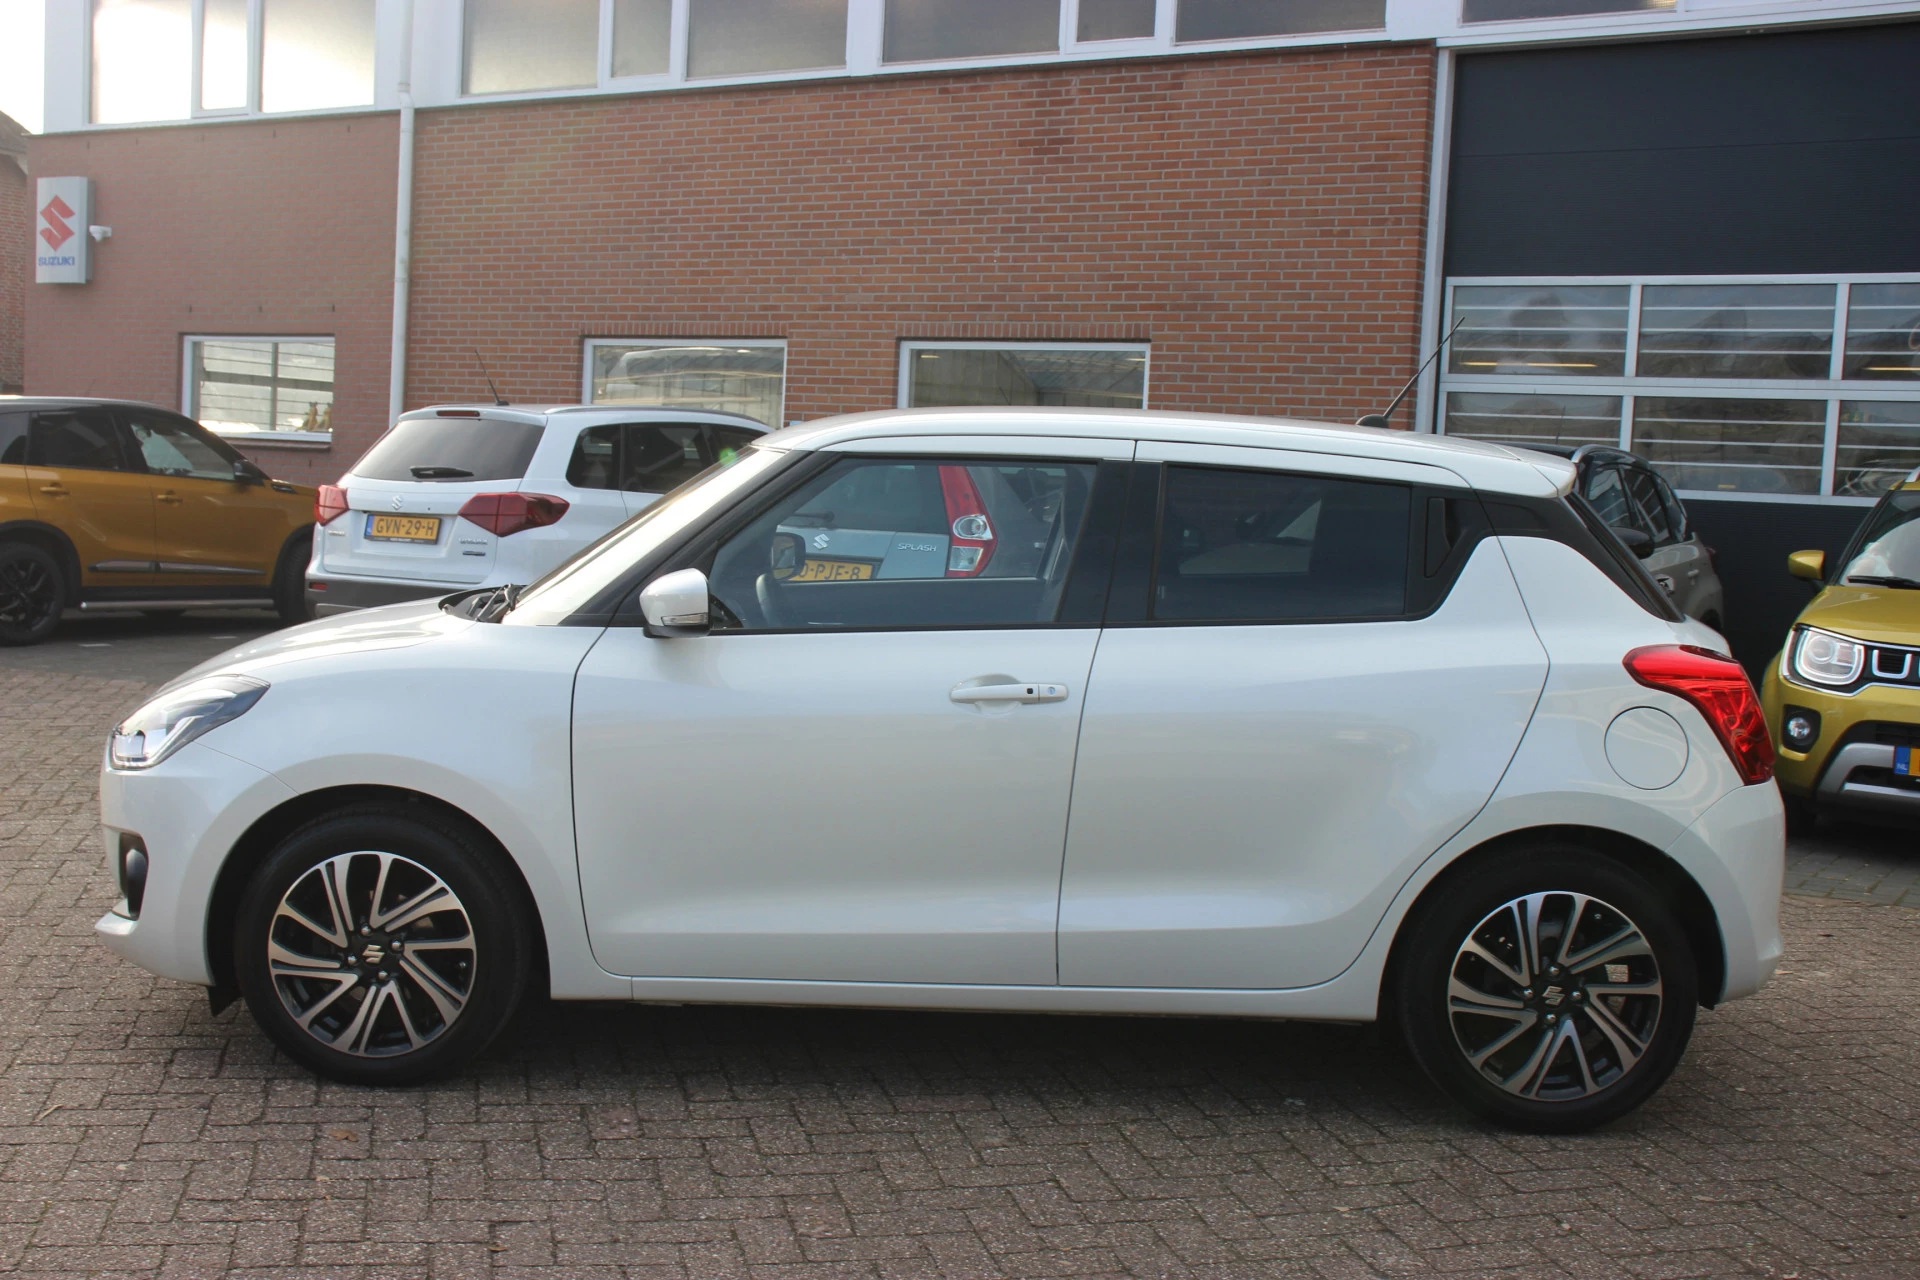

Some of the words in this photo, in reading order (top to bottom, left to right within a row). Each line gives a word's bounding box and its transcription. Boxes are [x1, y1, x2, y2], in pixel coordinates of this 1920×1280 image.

[38, 256, 75, 266] SUZUKI
[375, 518, 436, 537] GVN-29-H
[897, 542, 937, 552] SPLASH
